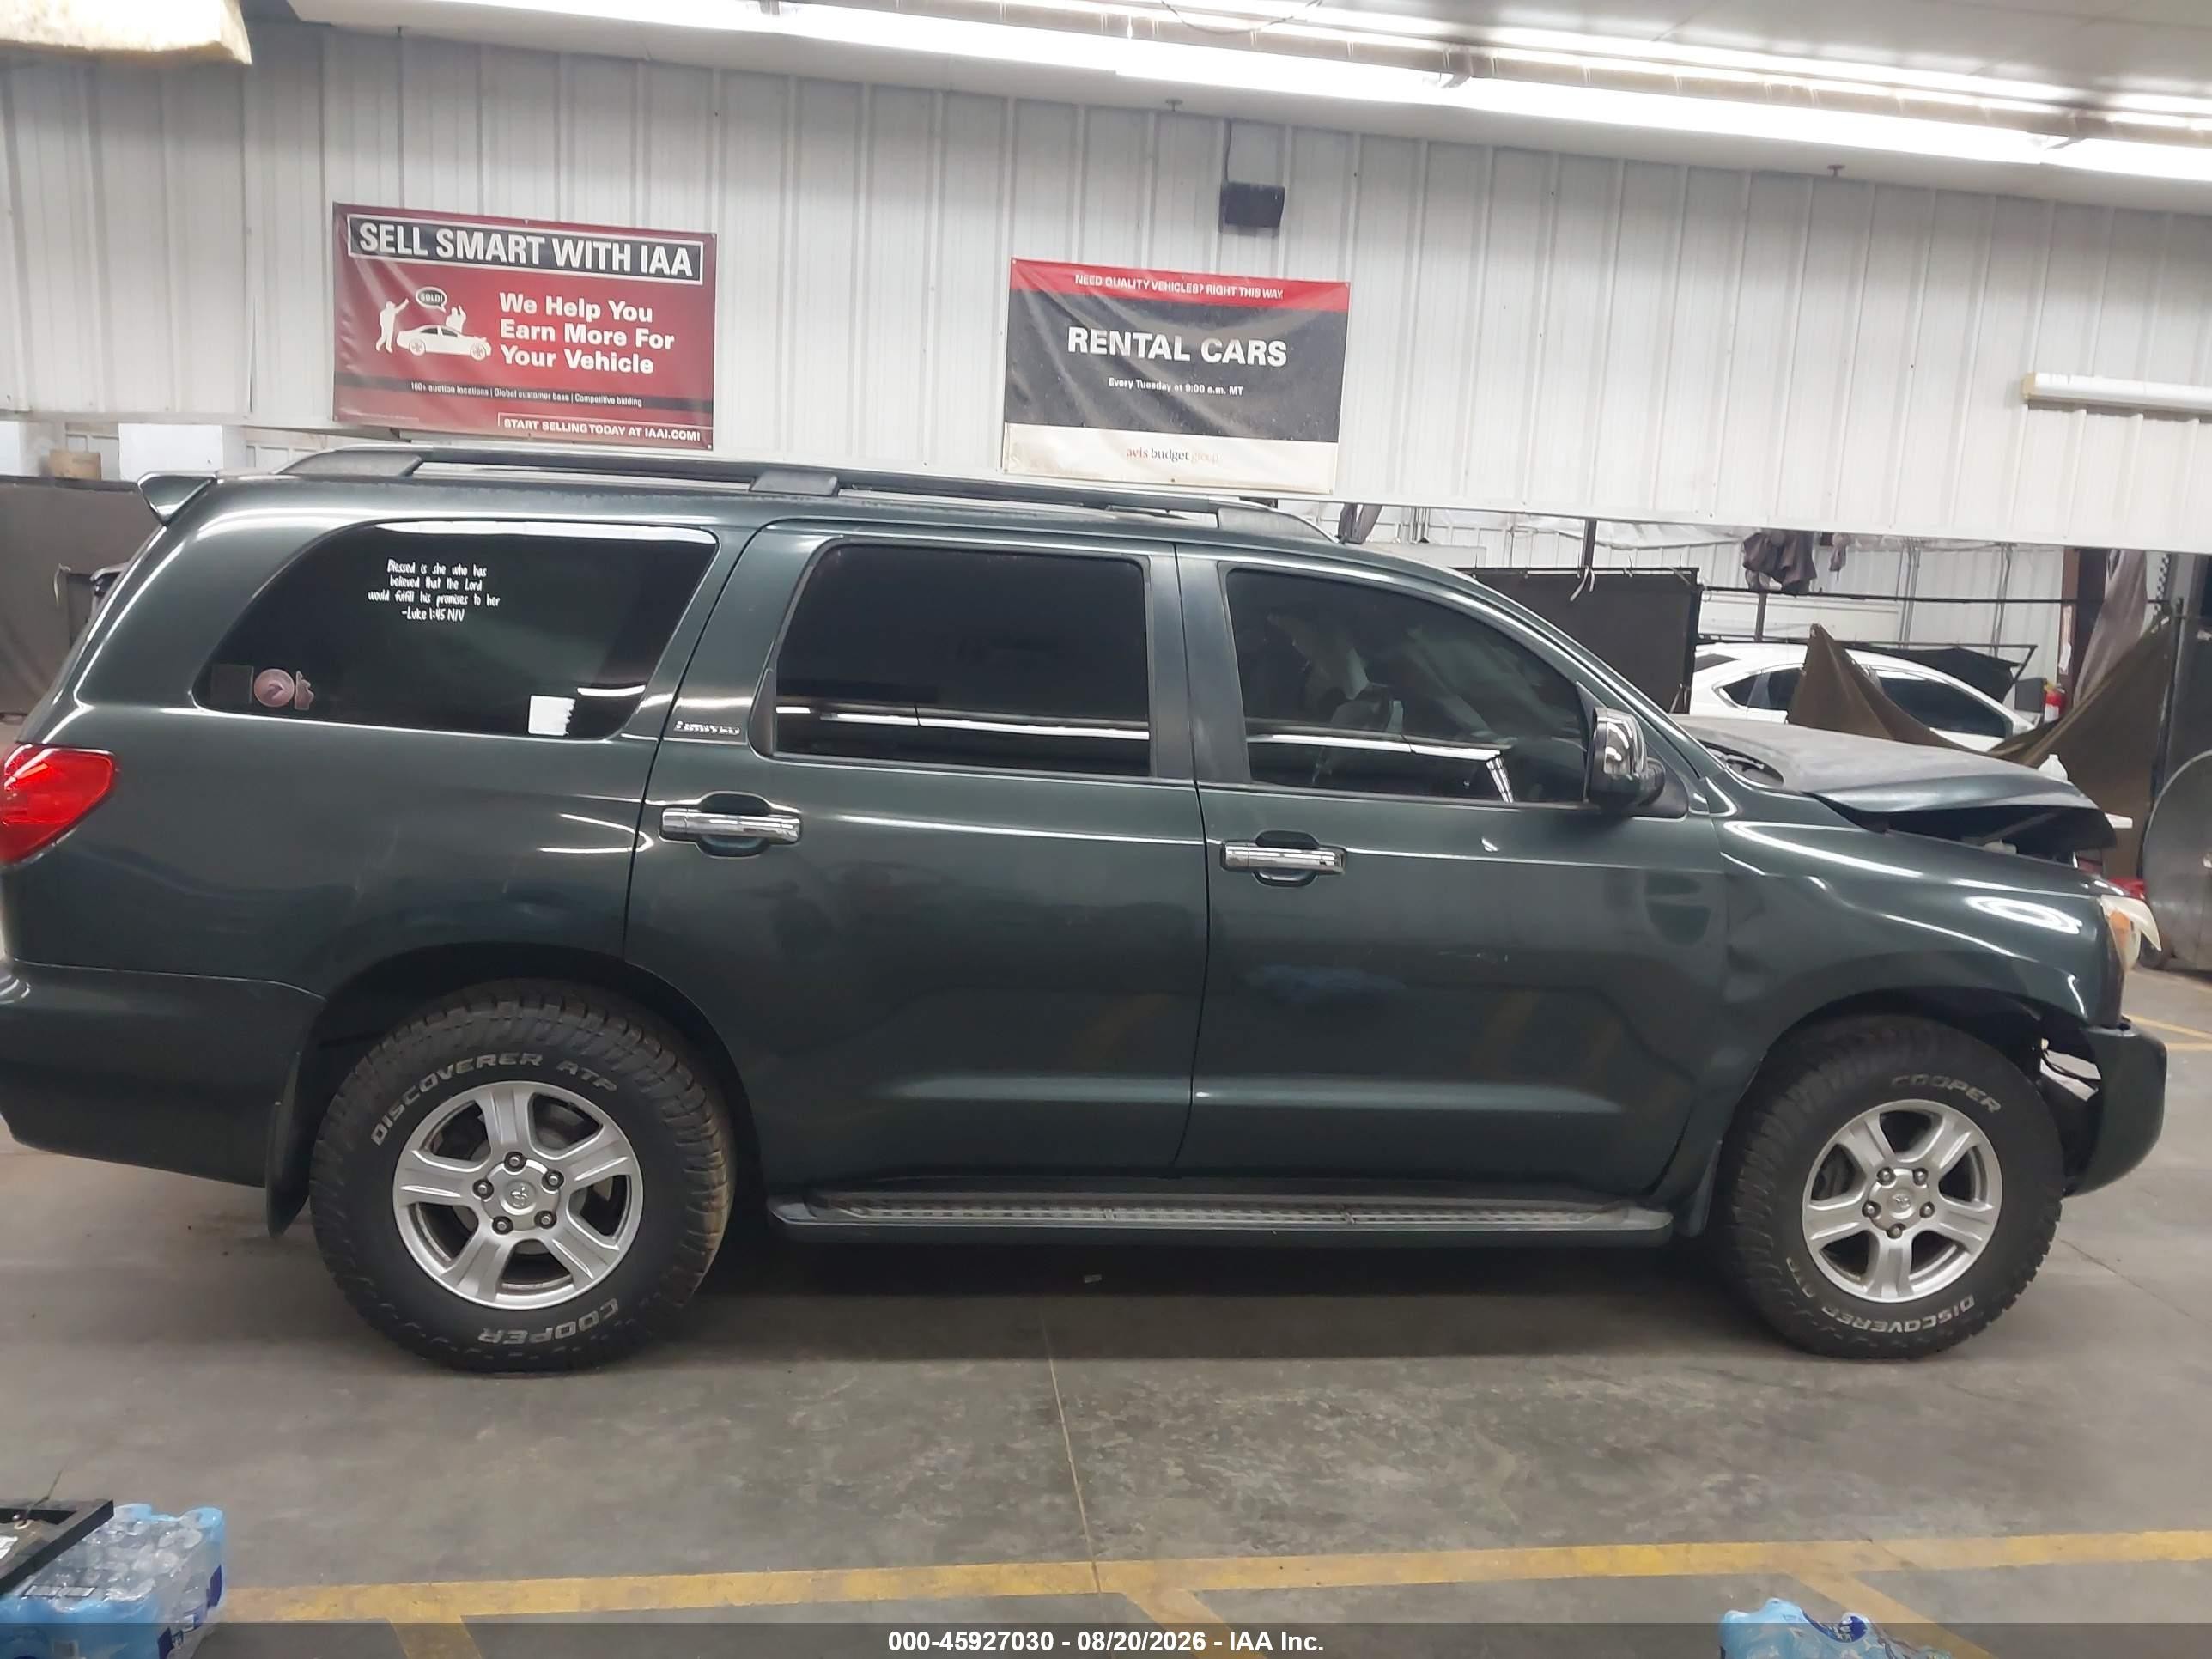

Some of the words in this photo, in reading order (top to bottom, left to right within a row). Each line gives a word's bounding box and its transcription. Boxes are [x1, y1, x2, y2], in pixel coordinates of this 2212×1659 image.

[359, 222, 428, 256] SELL
[436, 228, 545, 265] SMART
[551, 237, 631, 272] WITH
[641, 244, 693, 277] IAA
[1075, 274, 1103, 286] NEED
[1105, 276, 1150, 291] QUALITY
[1152, 280, 1204, 295] VEHICLES?
[1206, 284, 1237, 296] RIGHT
[1239, 287, 1261, 298] THIS
[499, 292, 538, 314] We
[545, 295, 601, 322] Help
[608, 299, 653, 323] You
[500, 319, 556, 342] Earn
[564, 322, 628, 347] More
[635, 327, 675, 350] For
[500, 344, 556, 368] Your
[563, 349, 654, 374] Vehicle
[1067, 326, 1191, 362] RENTAL
[1201, 337, 1287, 368] CARS
[428, 384, 455, 393] auction
[457, 386, 489, 396] locations
[494, 387, 517, 398] Global
[519, 391, 550, 400] customer
[552, 392, 569, 402] base
[574, 393, 616, 405] Competitive
[617, 396, 642, 408] bidding
[1109, 377, 1133, 390] Every
[1135, 379, 1172, 392] Tuesday
[1174, 383, 1183, 392] at
[1185, 383, 1206, 393] 9:00
[1207, 386, 1226, 395] a.m.
[1229, 386, 1244, 396] MT
[504, 417, 539, 430] START
[542, 421, 587, 434] SELLING
[589, 424, 626, 437] TODAY
[629, 426, 642, 437] AT
[1126, 447, 1149, 458] avis
[1151, 447, 1190, 462] budget
[387, 558, 416, 574] Blessed
[421, 563, 428, 574] is
[432, 562, 447, 575] she
[451, 562, 468, 576] who
[473, 563, 487, 577] has
[390, 574, 420, 588] believed
[425, 576, 441, 590] that
[447, 577, 459, 590] the
[465, 578, 482, 591] Lord
[368, 589, 390, 601] would
[420, 590, 431, 604] his
[436, 593, 468, 607] promises
[473, 593, 481, 606] to
[486, 593, 501, 606] her
[429, 607, 446, 620] 1:45
[447, 608, 465, 622] NIV
[370, 1052, 543, 1146] DISCOVERER
[1891, 1073, 2002, 1114] COOPER
[477, 1297, 618, 1344] COOPER
